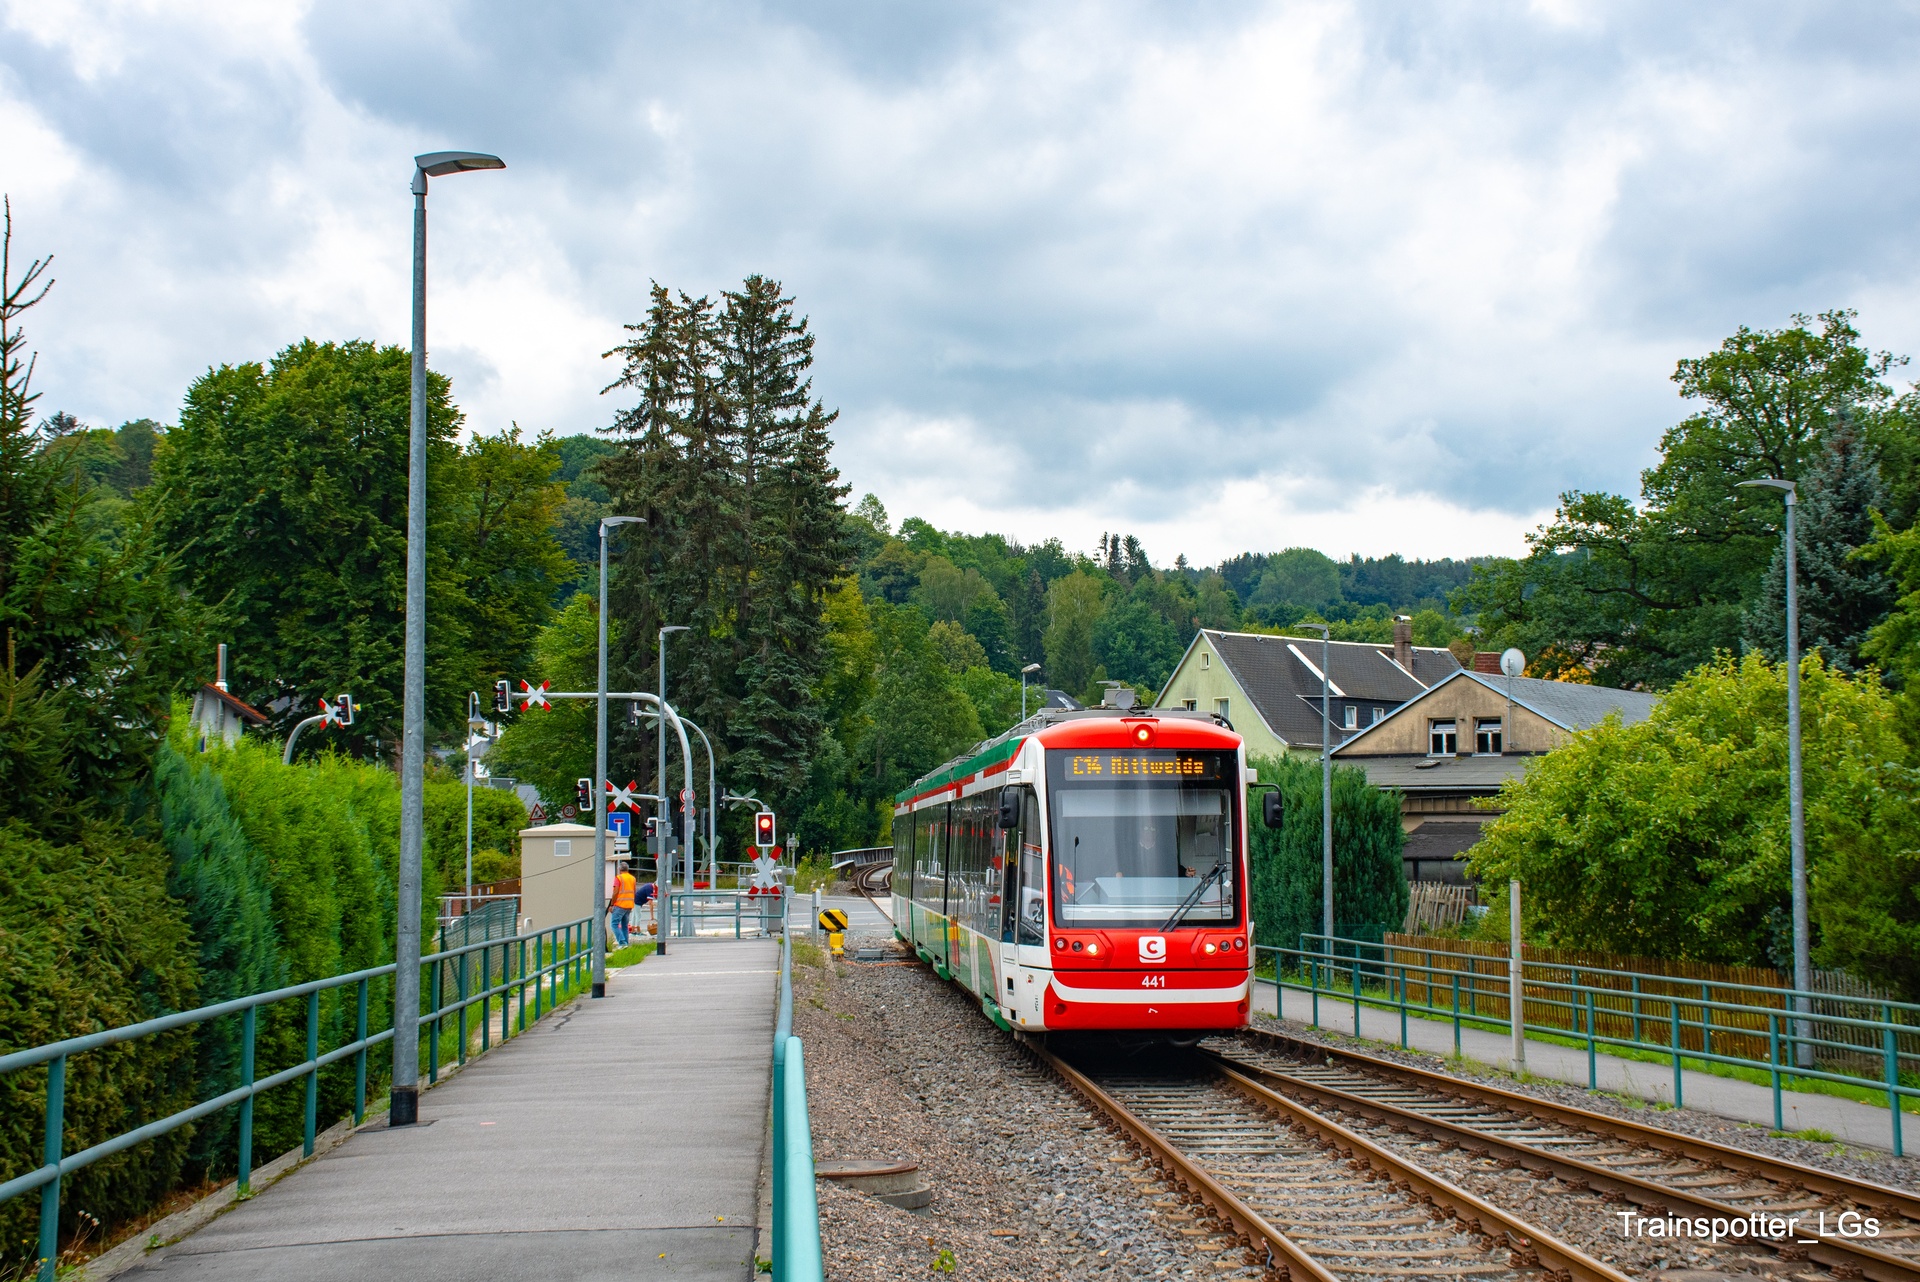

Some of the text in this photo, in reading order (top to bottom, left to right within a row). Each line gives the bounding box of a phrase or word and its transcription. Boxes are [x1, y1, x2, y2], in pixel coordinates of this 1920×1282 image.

[1073, 756, 1204, 775] C14 Mittweida
[565, 807, 574, 815] 30
[1146, 940, 1158, 954] C
[1141, 975, 1165, 988] 441
